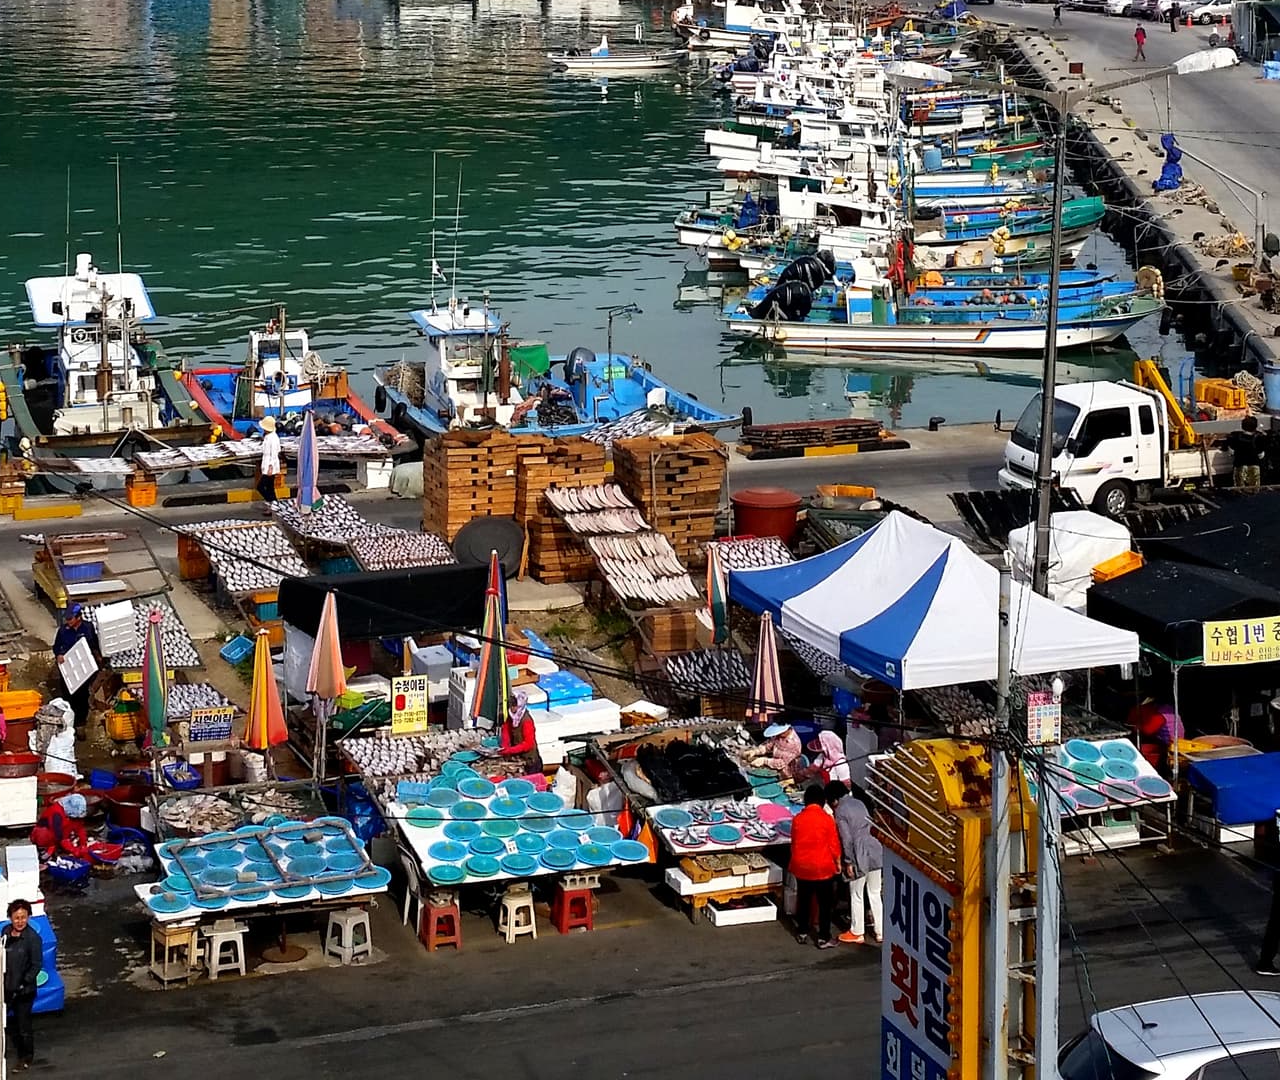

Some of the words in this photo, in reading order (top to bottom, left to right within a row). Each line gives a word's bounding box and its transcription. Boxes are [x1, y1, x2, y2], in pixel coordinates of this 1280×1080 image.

[1210, 626, 1238, 646] 수협
[1242, 623, 1265, 645] 1번
[1211, 648, 1254, 662] 나비수산
[394, 679, 425, 693] 수정이집
